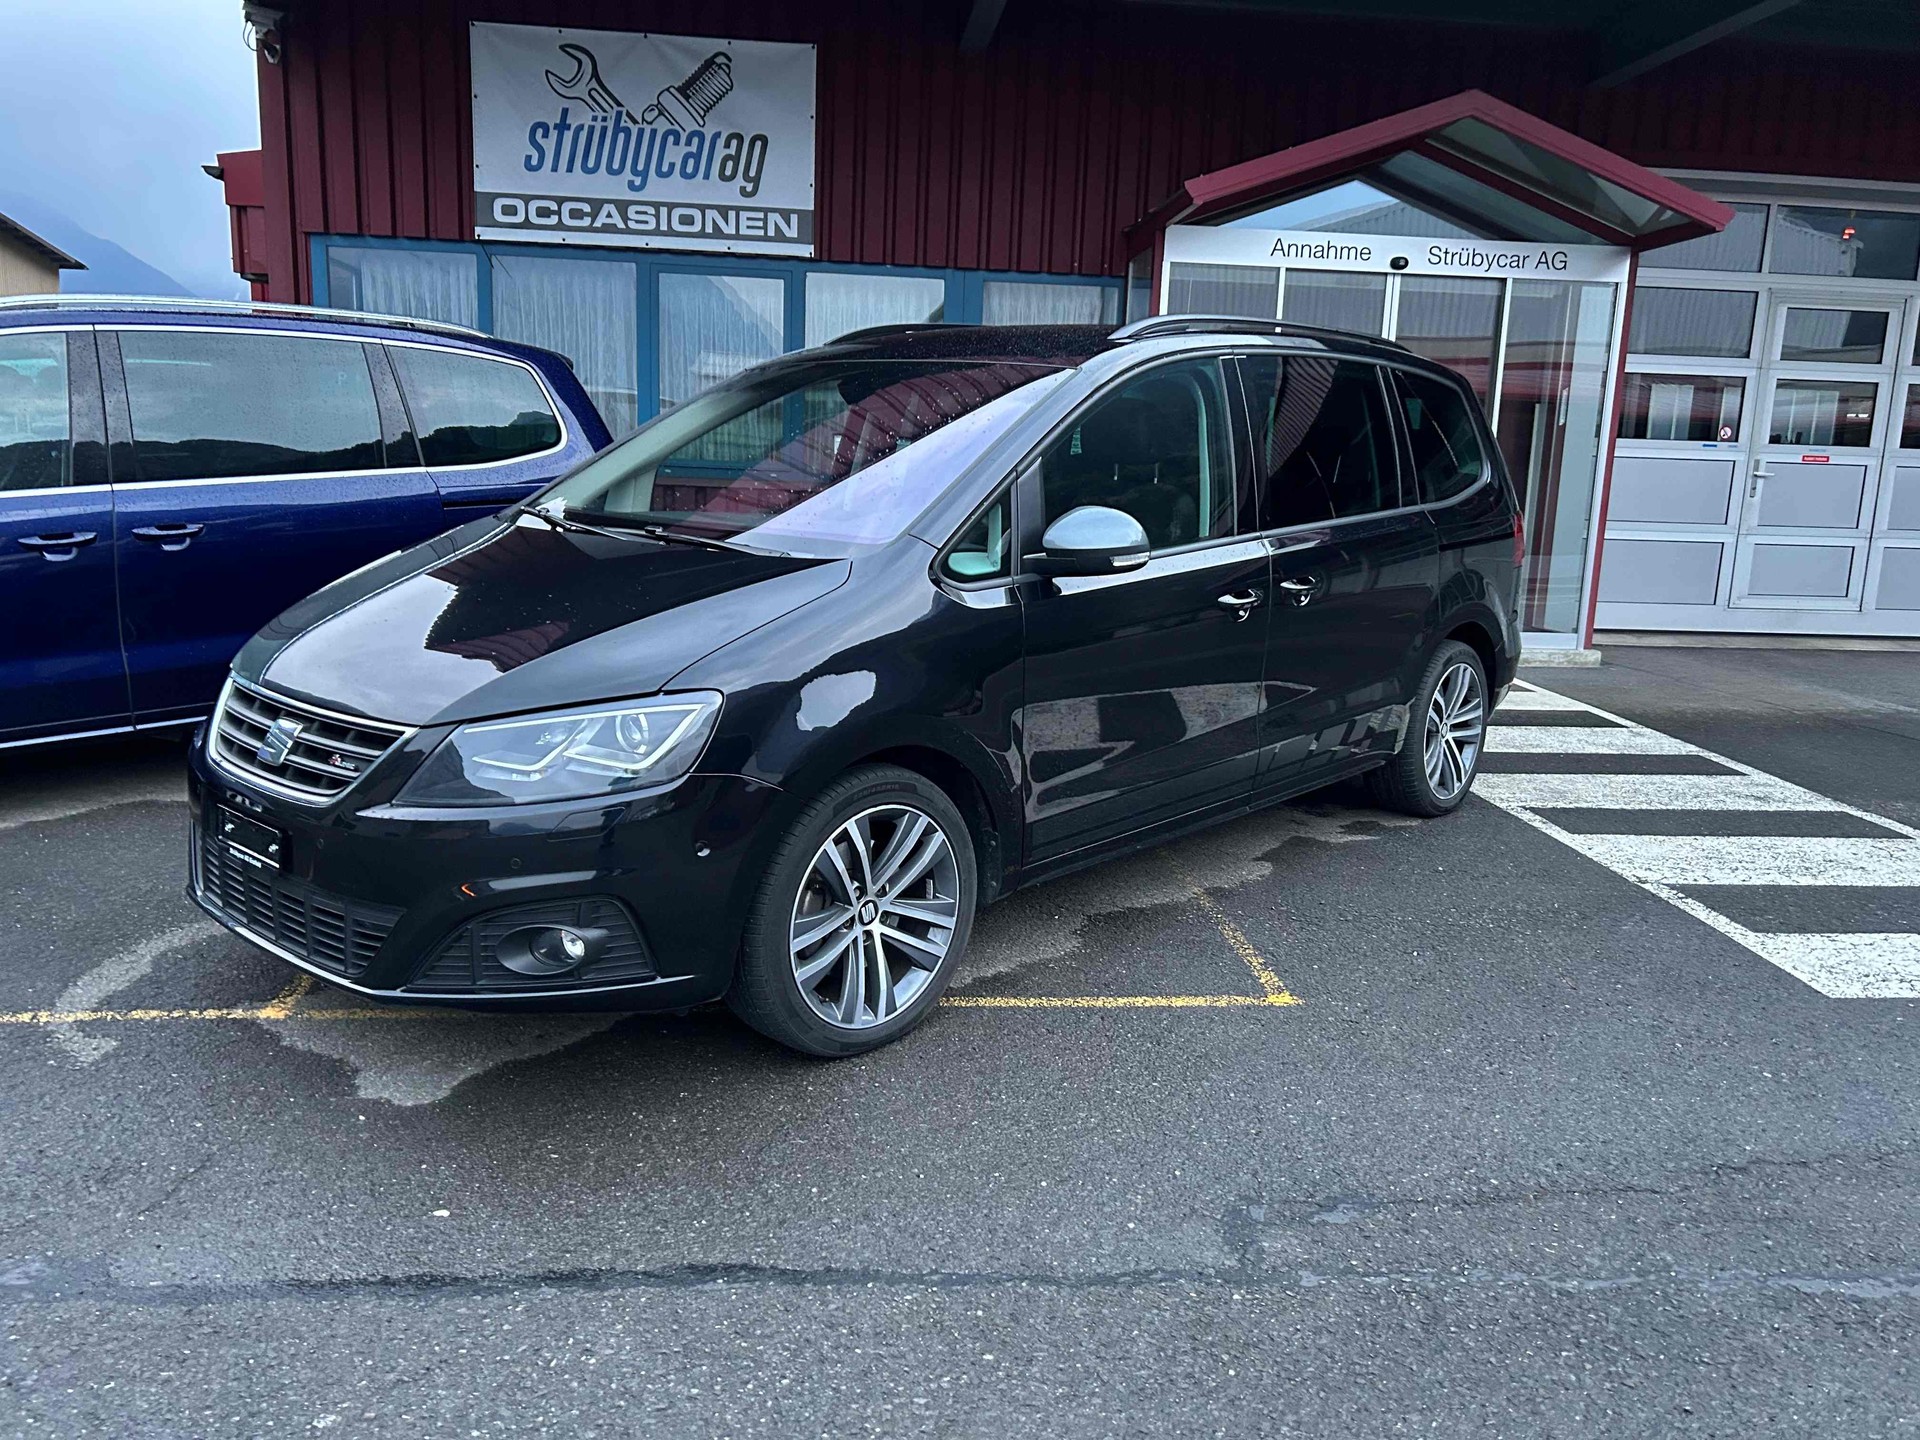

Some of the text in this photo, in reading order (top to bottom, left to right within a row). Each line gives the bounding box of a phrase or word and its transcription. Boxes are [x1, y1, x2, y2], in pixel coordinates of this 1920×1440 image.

[493, 197, 798, 238] OCCASIONEN
[1270, 238, 1568, 272] Annahme Strübycar AG
